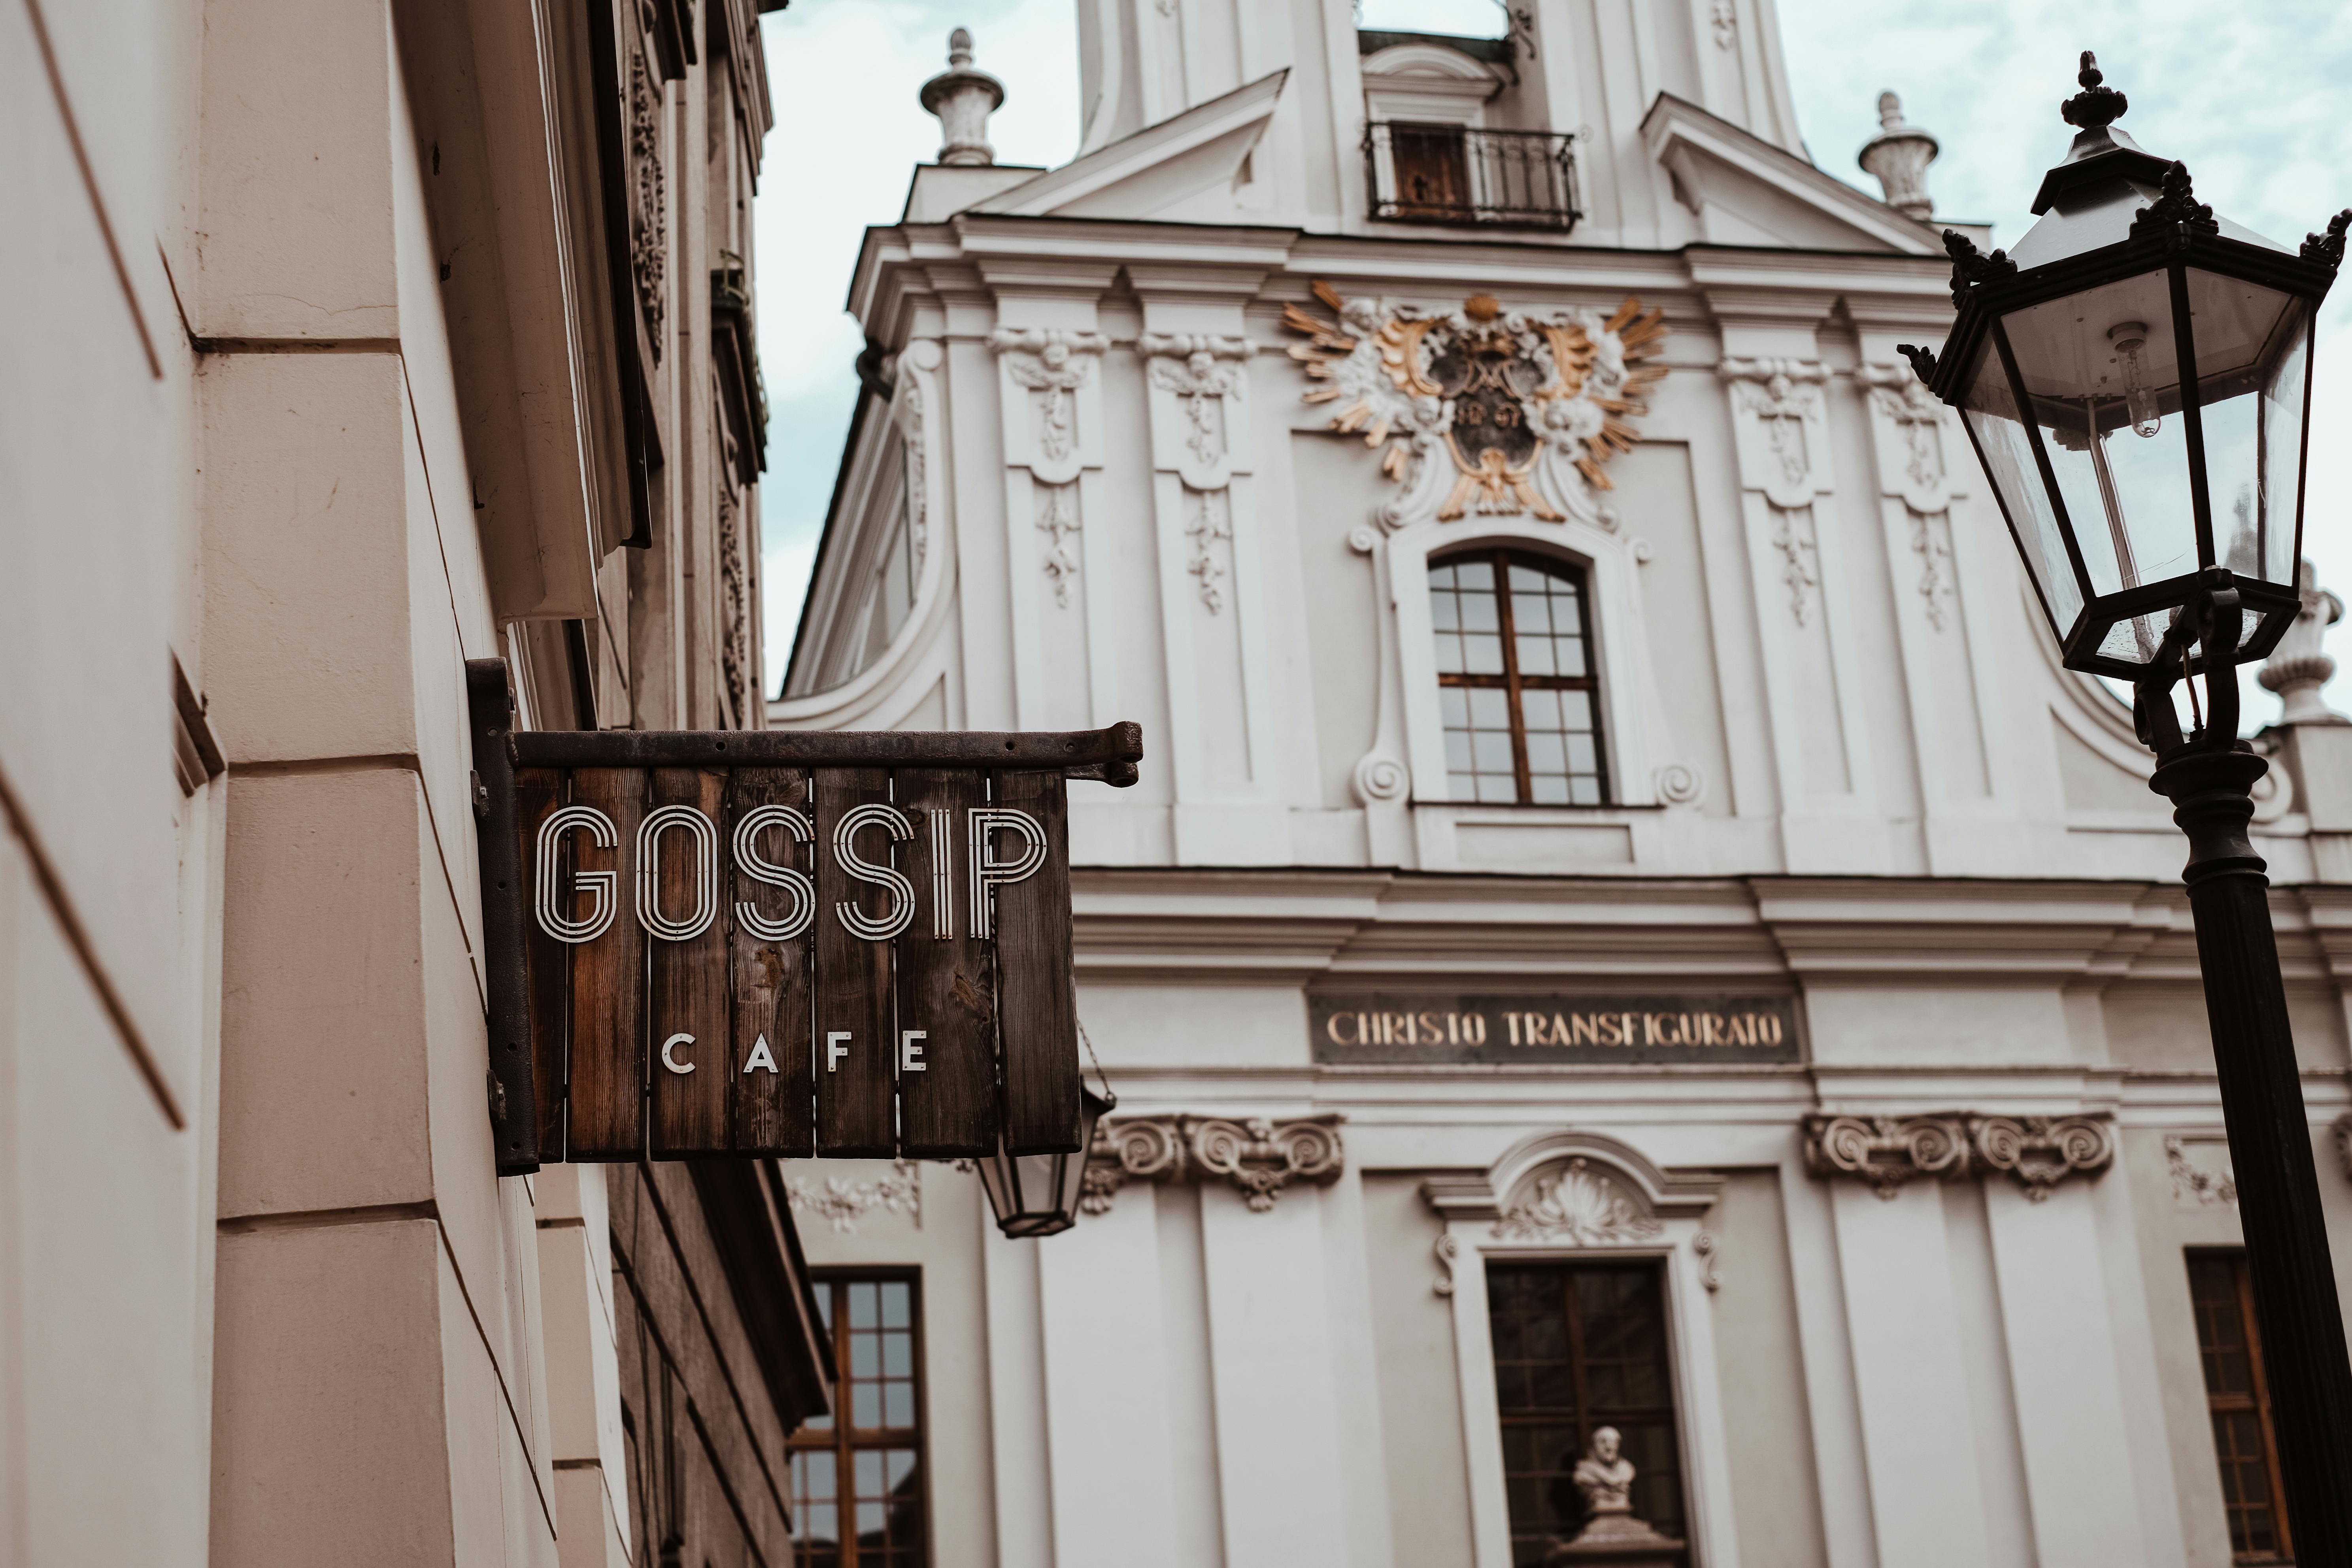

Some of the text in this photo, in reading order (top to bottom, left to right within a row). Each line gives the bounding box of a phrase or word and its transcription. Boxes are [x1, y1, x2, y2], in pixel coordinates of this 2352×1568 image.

[536, 804, 1047, 943] GOSSIP
[1327, 1011, 1782, 1047] CHRISTO TRANSFIGURATO
[662, 1030, 927, 1074] CAFE
